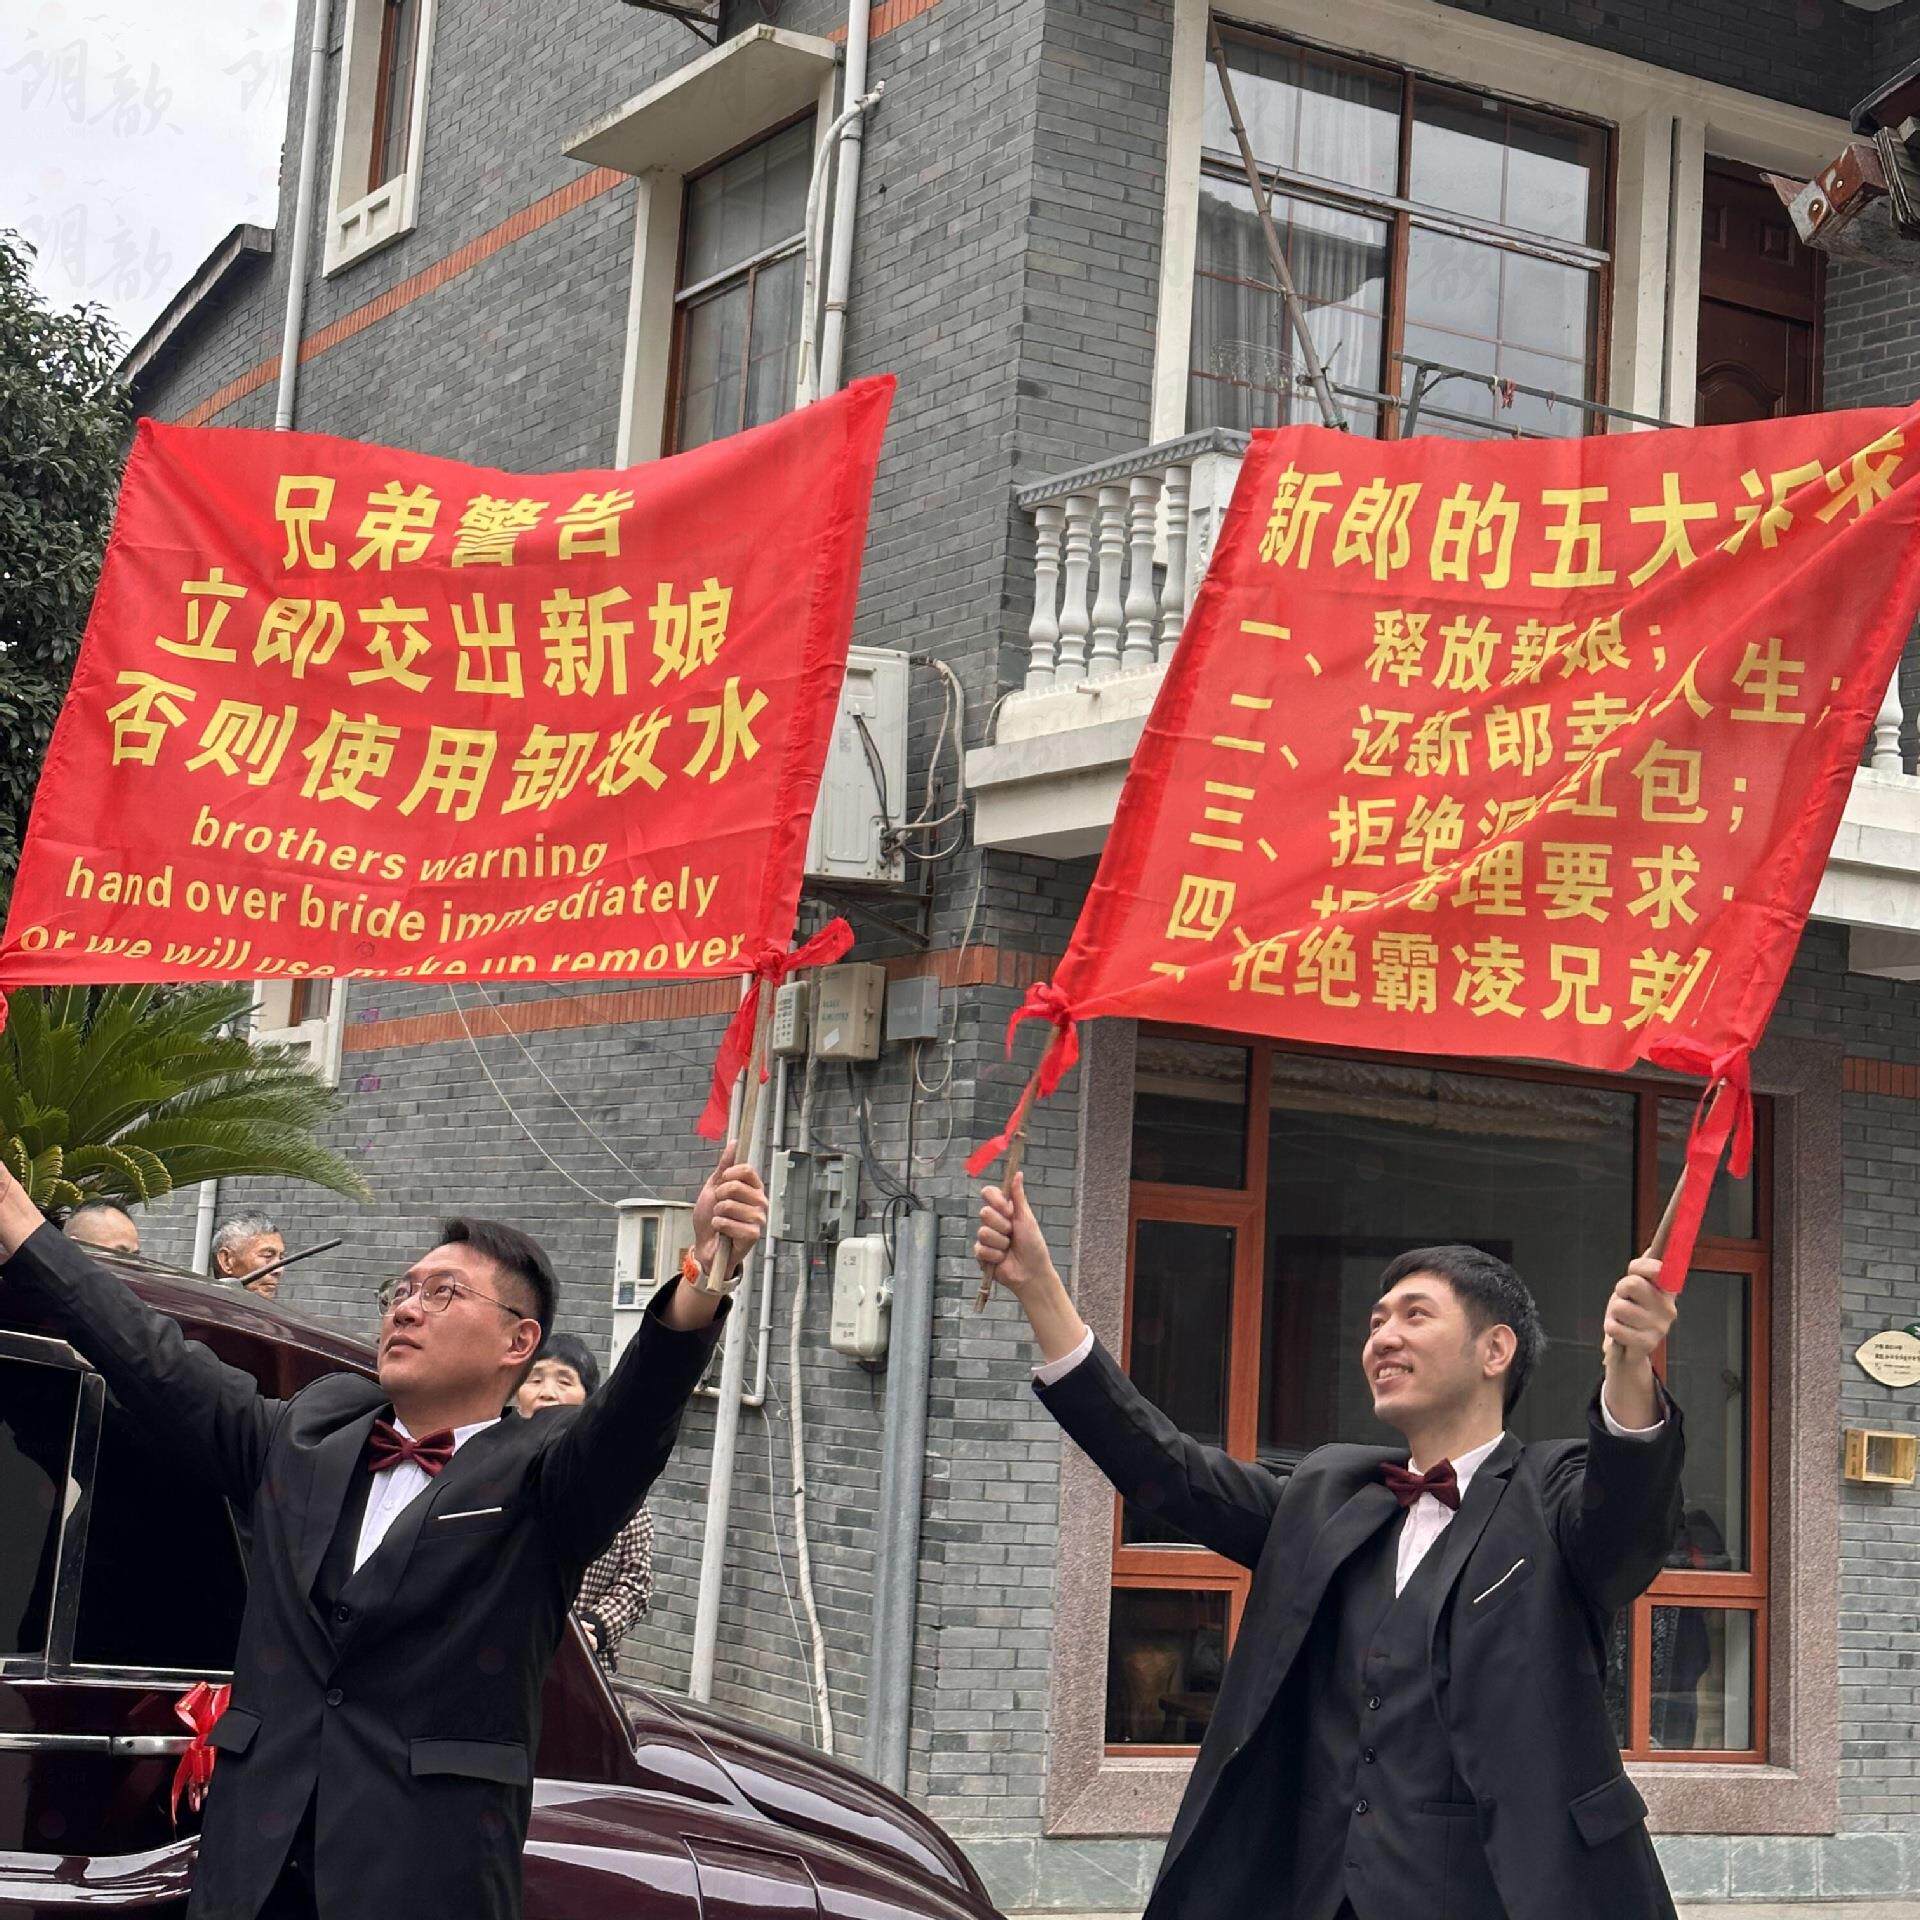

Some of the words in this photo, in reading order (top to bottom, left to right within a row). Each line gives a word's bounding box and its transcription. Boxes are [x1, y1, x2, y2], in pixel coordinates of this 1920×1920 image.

[275, 474, 635, 572] 兄弟警告
[156, 567, 733, 699] 立即交出新娘
[105, 670, 770, 822] 否则使用卸妆水
[191, 805, 406, 882] brothers
[419, 834, 608, 879] warning
[66, 857, 173, 908] hand
[185, 880, 285, 922] over
[300, 883, 426, 943] bride
[440, 865, 720, 945] immediately
[20, 925, 76, 951] or
[84, 933, 152, 959] we
[161, 937, 251, 970] will
[254, 956, 336, 977] use
[551, 931, 746, 974] remover
